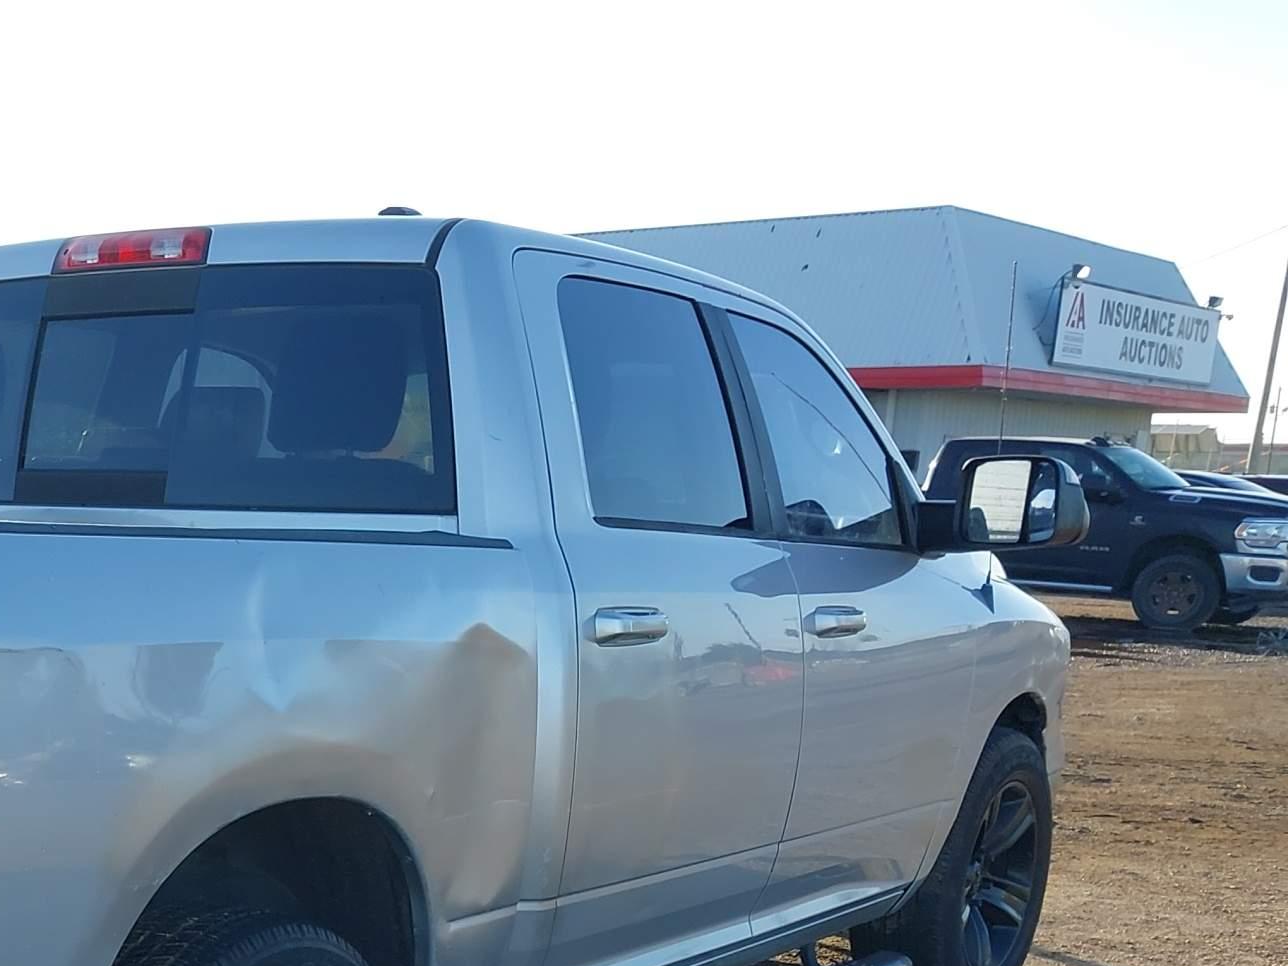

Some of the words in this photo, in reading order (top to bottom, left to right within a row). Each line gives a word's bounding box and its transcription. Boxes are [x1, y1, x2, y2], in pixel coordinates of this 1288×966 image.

[1099, 298, 1176, 337] INSURANCE
[1176, 314, 1210, 343] AUTO
[1119, 335, 1184, 370] AUCTIONS
